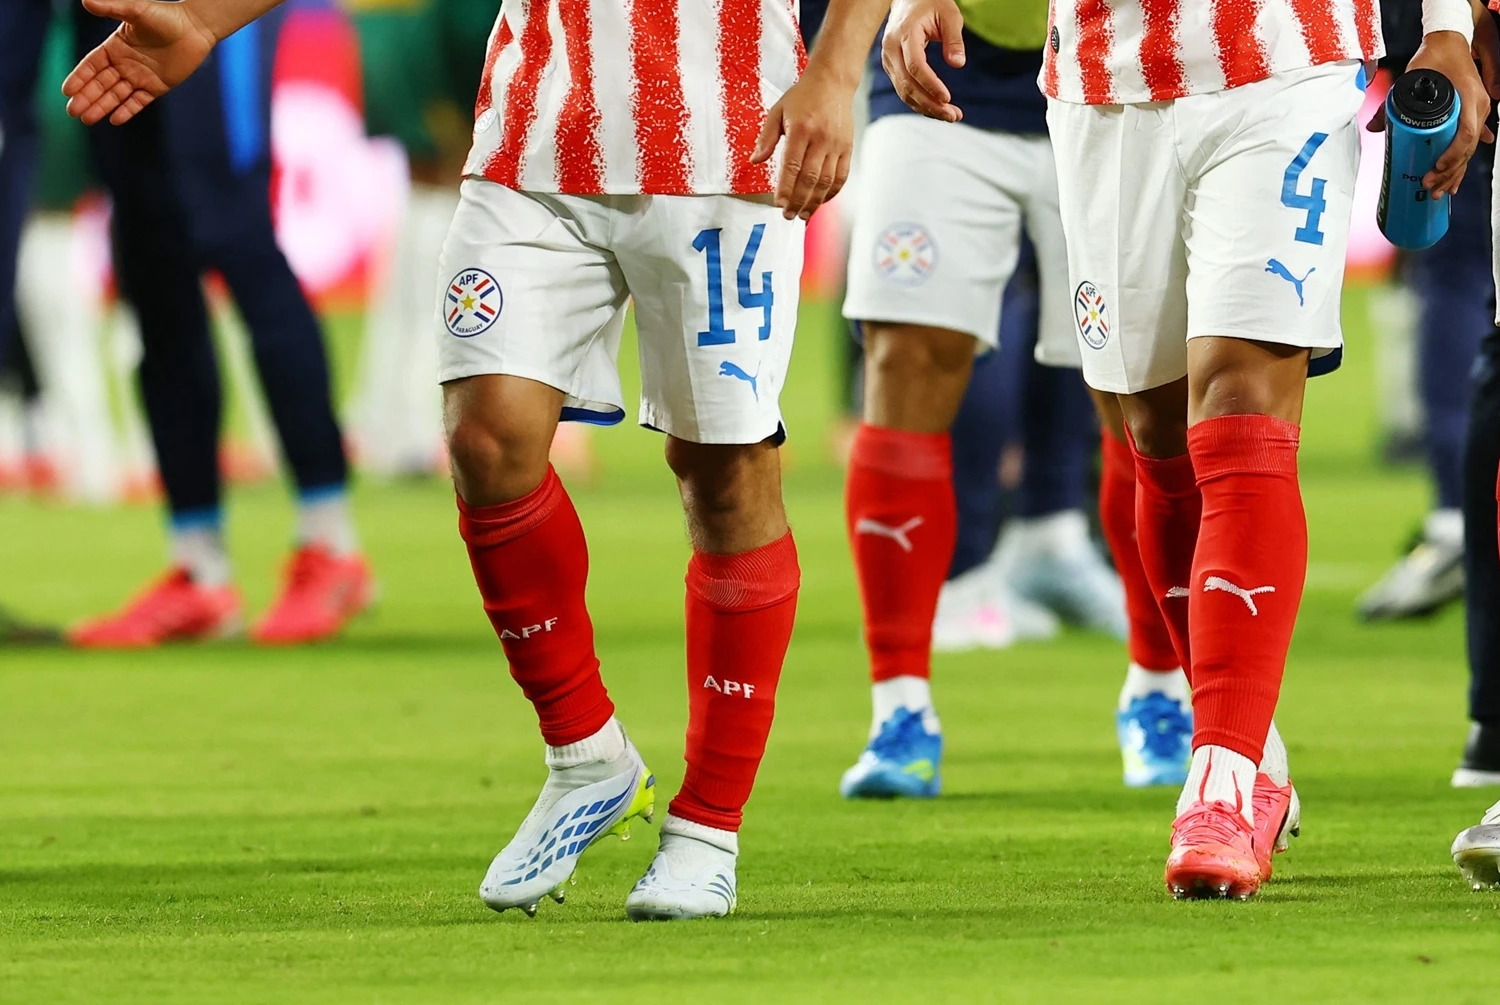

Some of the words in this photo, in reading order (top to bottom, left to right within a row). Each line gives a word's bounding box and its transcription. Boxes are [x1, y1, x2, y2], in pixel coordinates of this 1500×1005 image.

[1400, 113, 1450, 128] POWERADE
[1280, 131, 1329, 246] 4
[458, 273, 479, 287] APF
[691, 223, 774, 346] 14
[1085, 286, 1096, 298] APF
[455, 323, 483, 334] PARAGUAY
[500, 616, 558, 640] APF
[703, 675, 756, 699] APF
